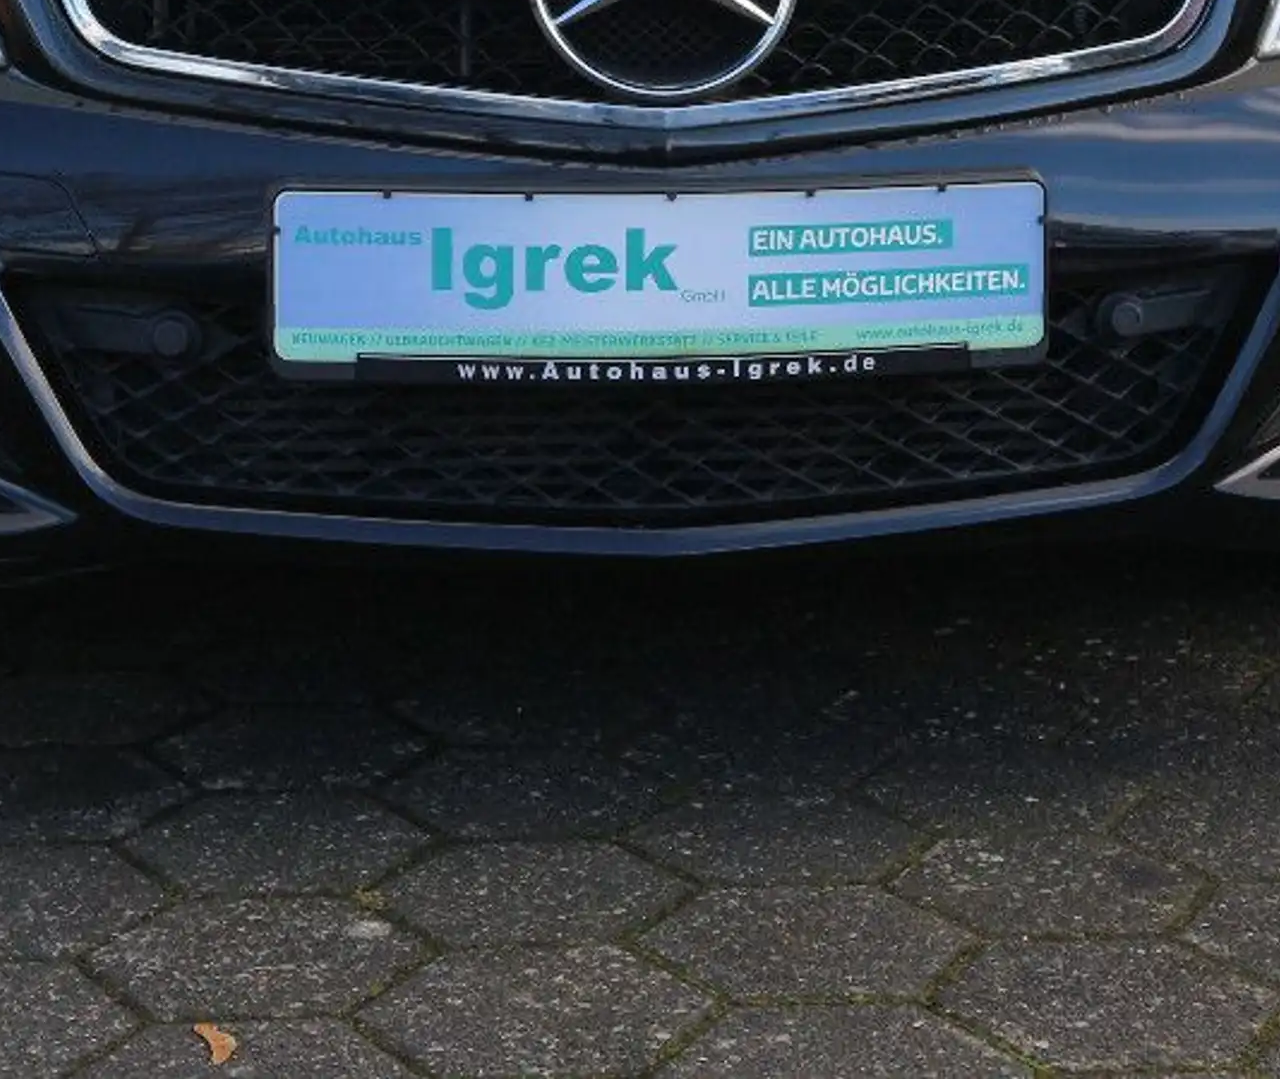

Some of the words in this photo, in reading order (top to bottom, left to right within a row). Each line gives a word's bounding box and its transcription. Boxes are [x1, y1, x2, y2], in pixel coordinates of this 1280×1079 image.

[752, 229, 794, 251] EIN
[800, 224, 944, 250] AUTOHAUS.
[294, 225, 422, 245] Autohaus
[431, 227, 677, 310] Igrek
[752, 278, 817, 301] ALLE
[822, 268, 1026, 298] MÖGLICHKEITEN.
[457, 355, 876, 381] www.Autohaus-Igrek.de
